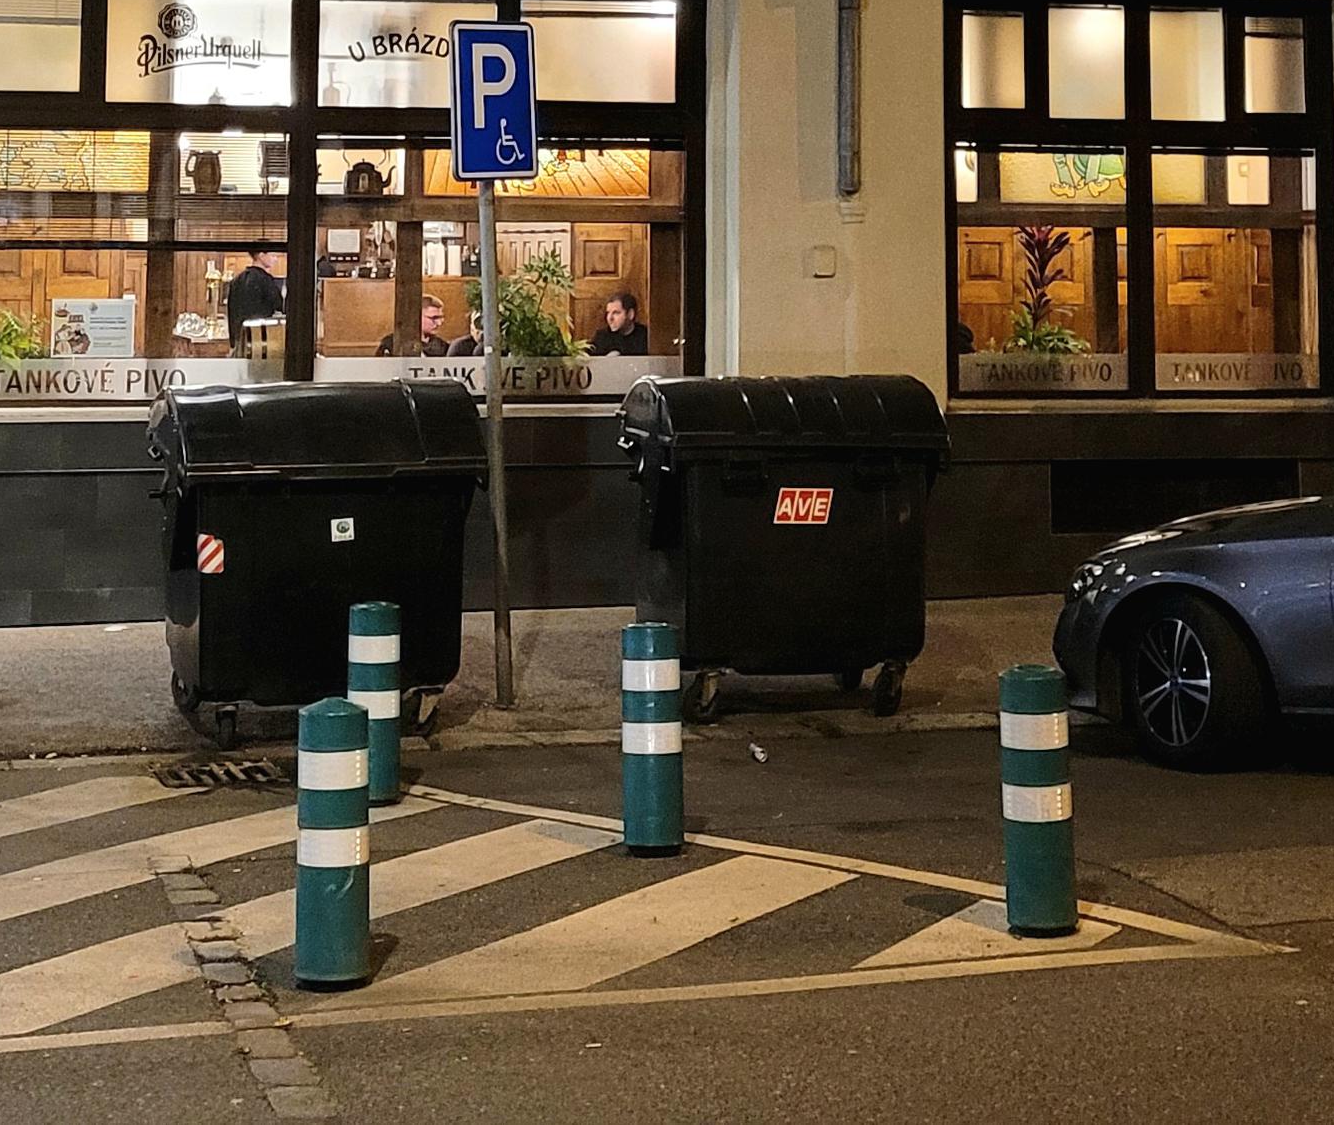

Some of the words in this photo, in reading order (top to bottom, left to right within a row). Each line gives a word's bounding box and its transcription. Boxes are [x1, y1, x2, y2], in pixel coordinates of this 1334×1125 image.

[136, 34, 203, 77] Pilsner
[201, 35, 263, 69] Urquell
[348, 43, 365, 63] U
[372, 27, 450, 59] BRÁZD
[472, 43, 517, 129] P
[126, 369, 187, 394] PIVO
[536, 365, 593, 390] PIVO
[1273, 361, 1304, 382] IVO
[777, 496, 829, 517] AVE
